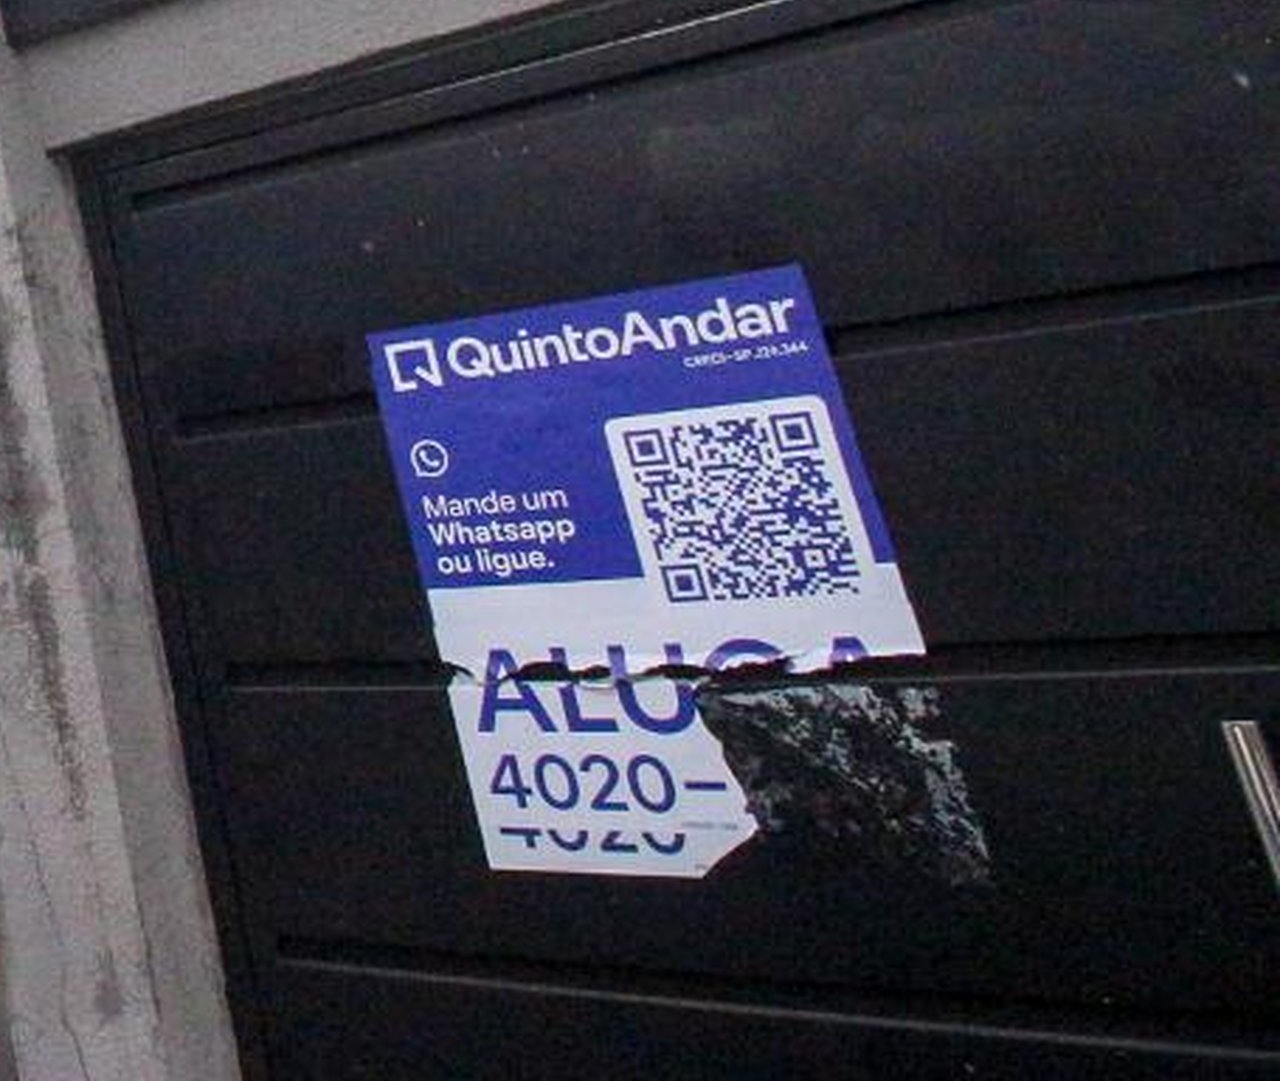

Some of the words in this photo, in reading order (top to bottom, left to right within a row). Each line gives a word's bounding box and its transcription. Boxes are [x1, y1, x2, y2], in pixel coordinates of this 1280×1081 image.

[446, 297, 795, 380] QuintoAndar
[422, 490, 516, 518] Mande
[522, 489, 569, 511] um
[427, 519, 575, 546] Whatsapp
[437, 554, 473, 574] ou
[474, 549, 555, 577] ligue.
[490, 754, 727, 815] 4020-
